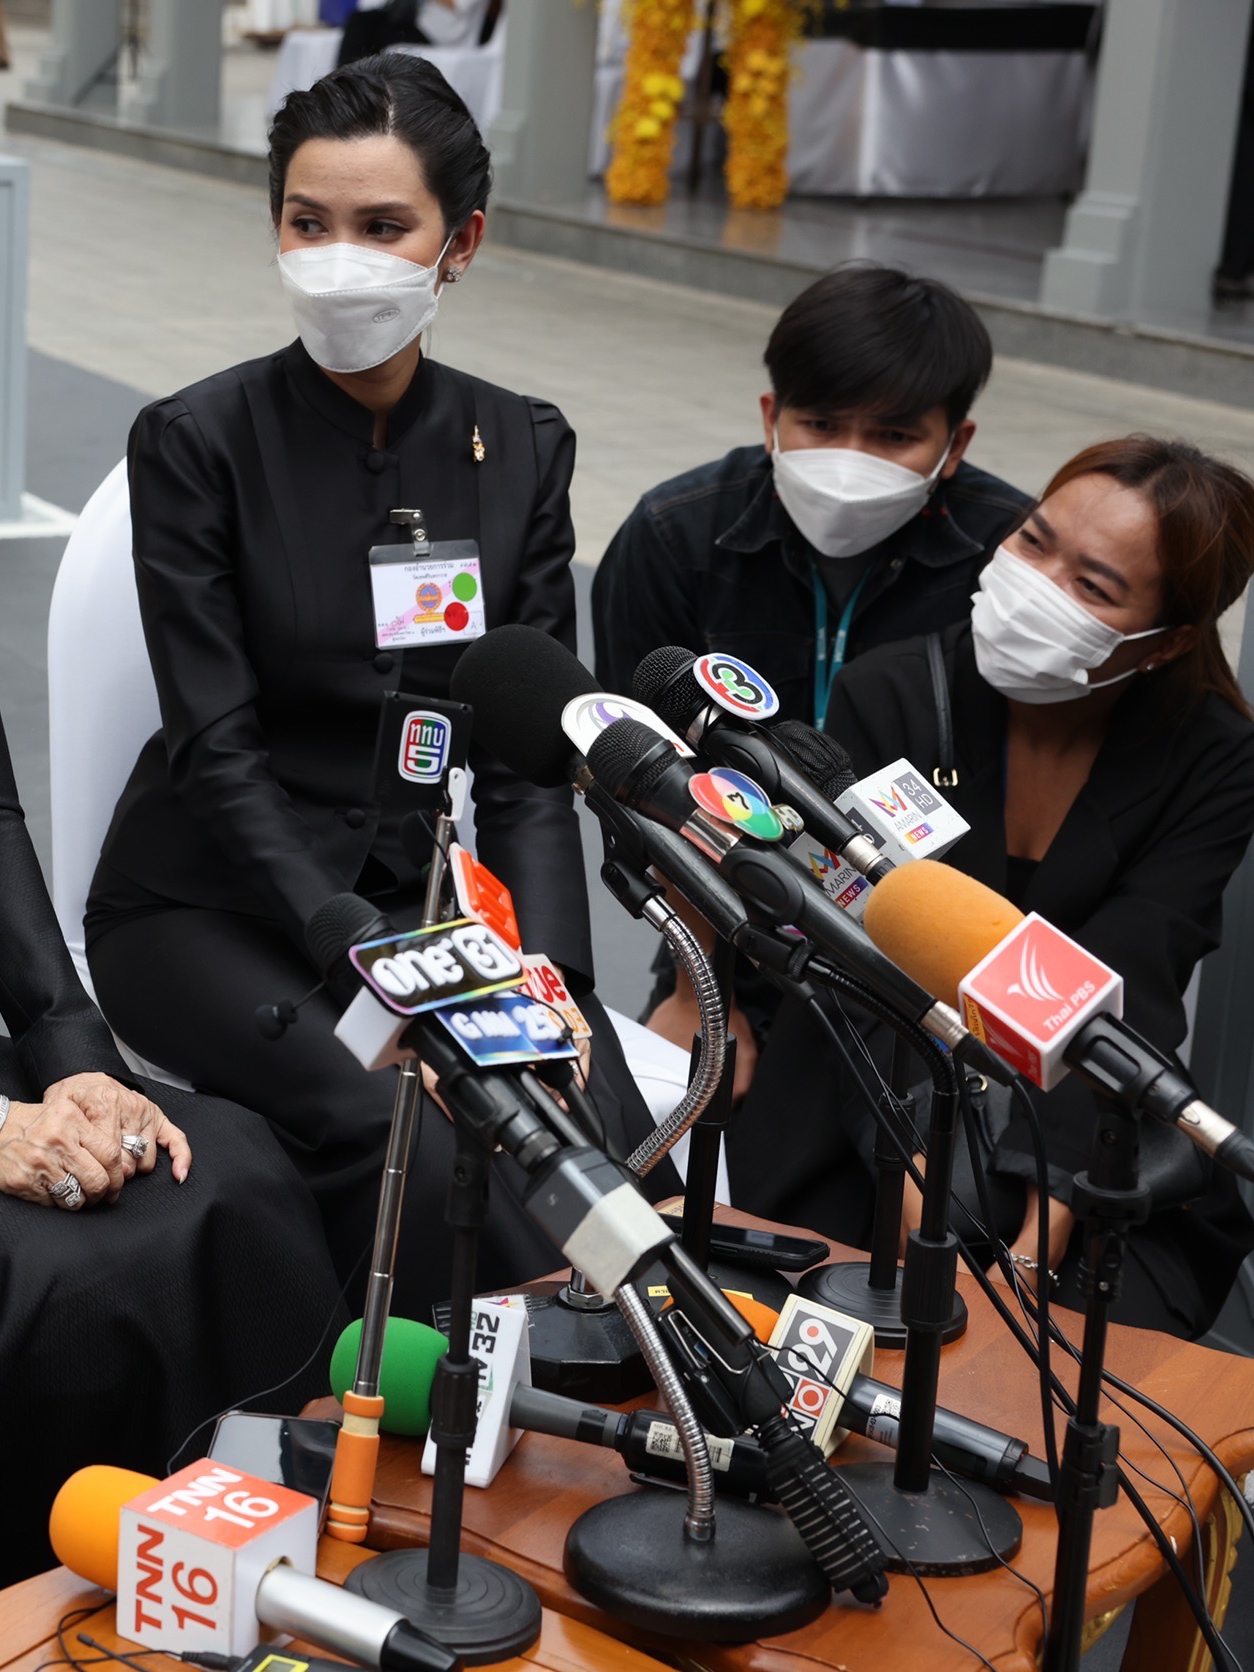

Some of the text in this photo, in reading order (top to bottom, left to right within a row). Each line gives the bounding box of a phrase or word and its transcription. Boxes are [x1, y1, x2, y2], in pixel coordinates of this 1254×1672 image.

[710, 661, 763, 705] 3
[406, 744, 441, 774] 5
[727, 791, 749, 810] 7
[902, 779, 921, 796] 34
[914, 793, 933, 809] HD
[895, 811, 923, 832] AMARIN
[910, 826, 930, 842] NEWS
[826, 866, 857, 897] MARIN
[837, 883, 862, 908] NEWS
[371, 938, 464, 996] one
[1043, 980, 1096, 1031] Thai PBS
[472, 1311, 500, 1354] 32
[788, 1318, 838, 1382] 29
[146, 1467, 243, 1516] TNN
[204, 1491, 279, 1528] 16
[135, 1523, 164, 1633] TNN
[171, 1561, 218, 1630] 16
